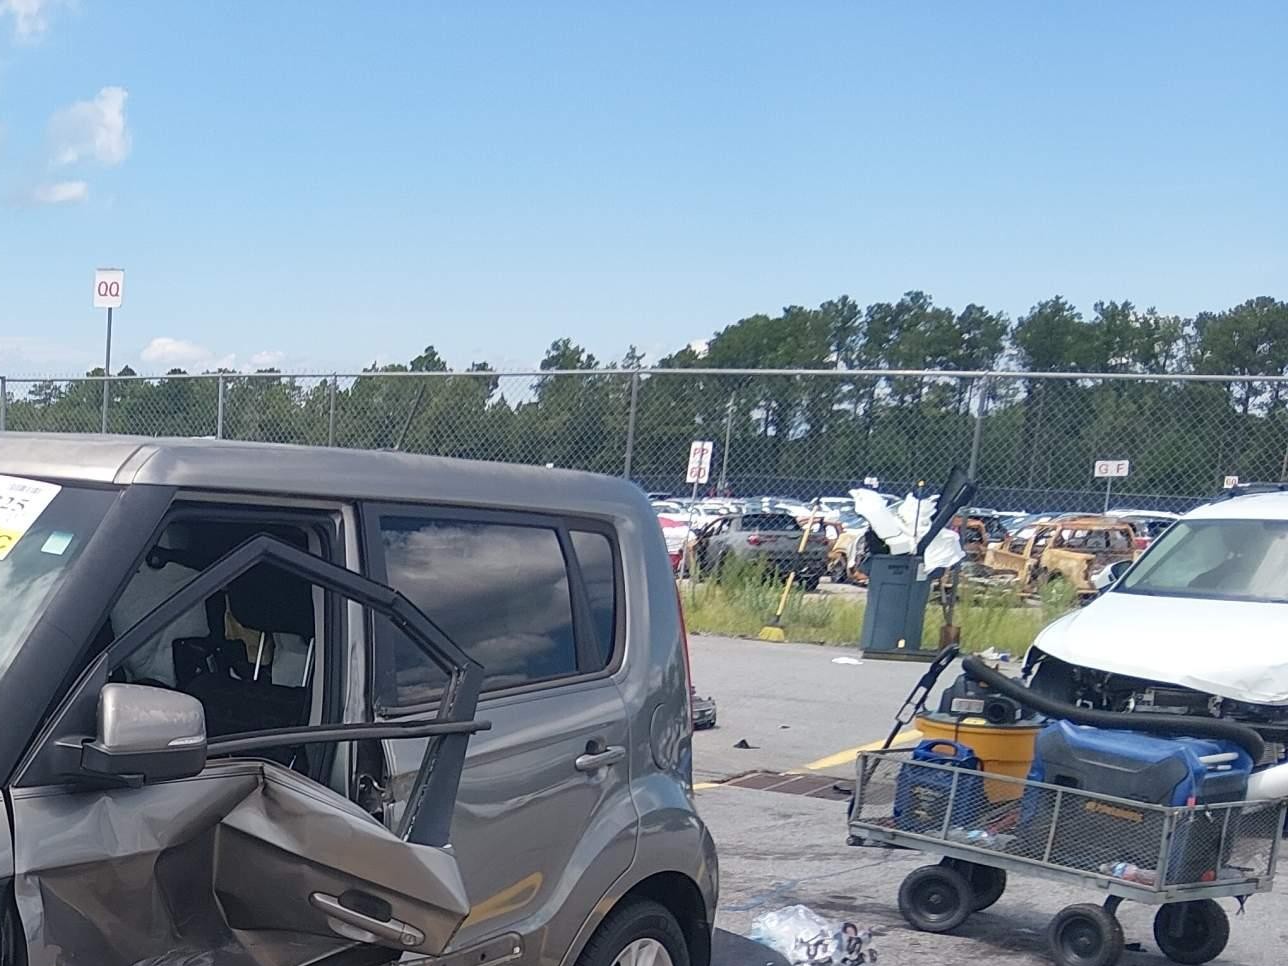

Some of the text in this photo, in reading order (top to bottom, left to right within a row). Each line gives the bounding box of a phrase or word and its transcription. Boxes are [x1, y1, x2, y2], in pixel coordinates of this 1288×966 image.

[97, 280, 120, 298] QQ
[692, 447, 709, 459] PP
[1116, 463, 1126, 474] F
